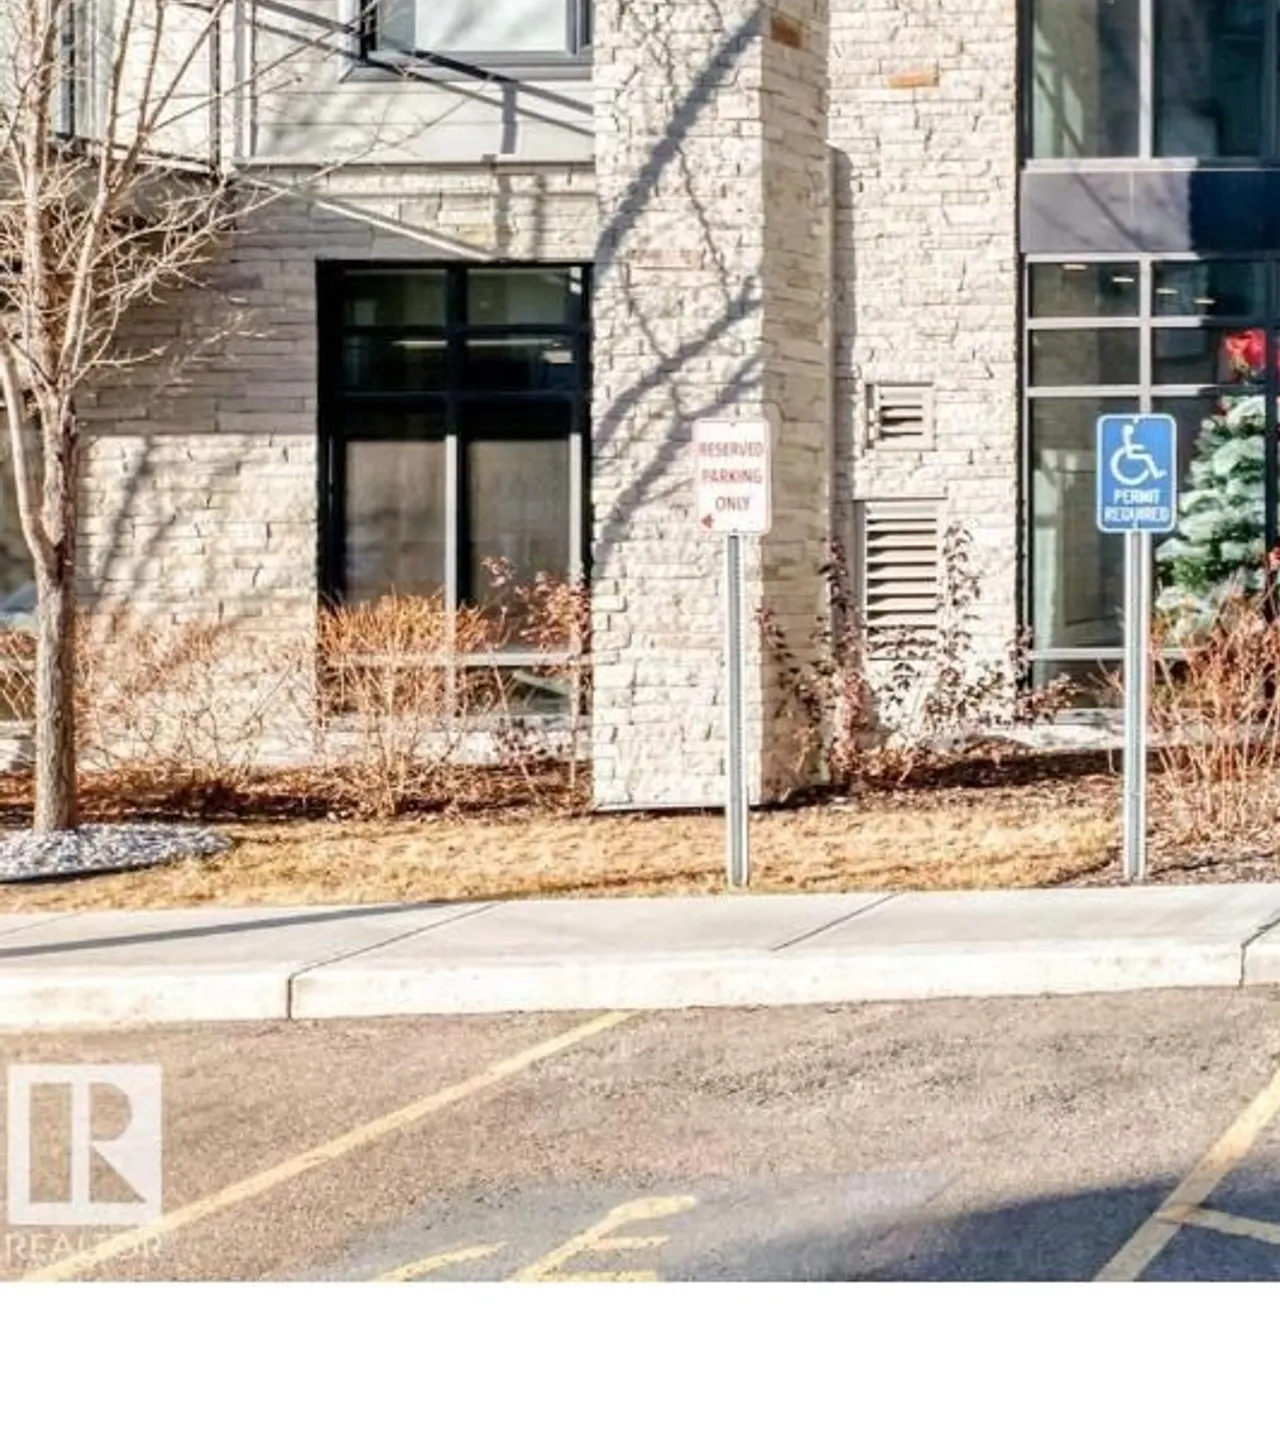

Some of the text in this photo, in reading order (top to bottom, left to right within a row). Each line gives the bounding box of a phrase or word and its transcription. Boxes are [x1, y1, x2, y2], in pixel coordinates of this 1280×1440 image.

[699, 441, 763, 457] RESERVED
[701, 468, 761, 484] PARKING
[715, 497, 750, 511] ONLY
[1113, 488, 1160, 505] PERMIT
[1104, 506, 1170, 521] REQUIRED
